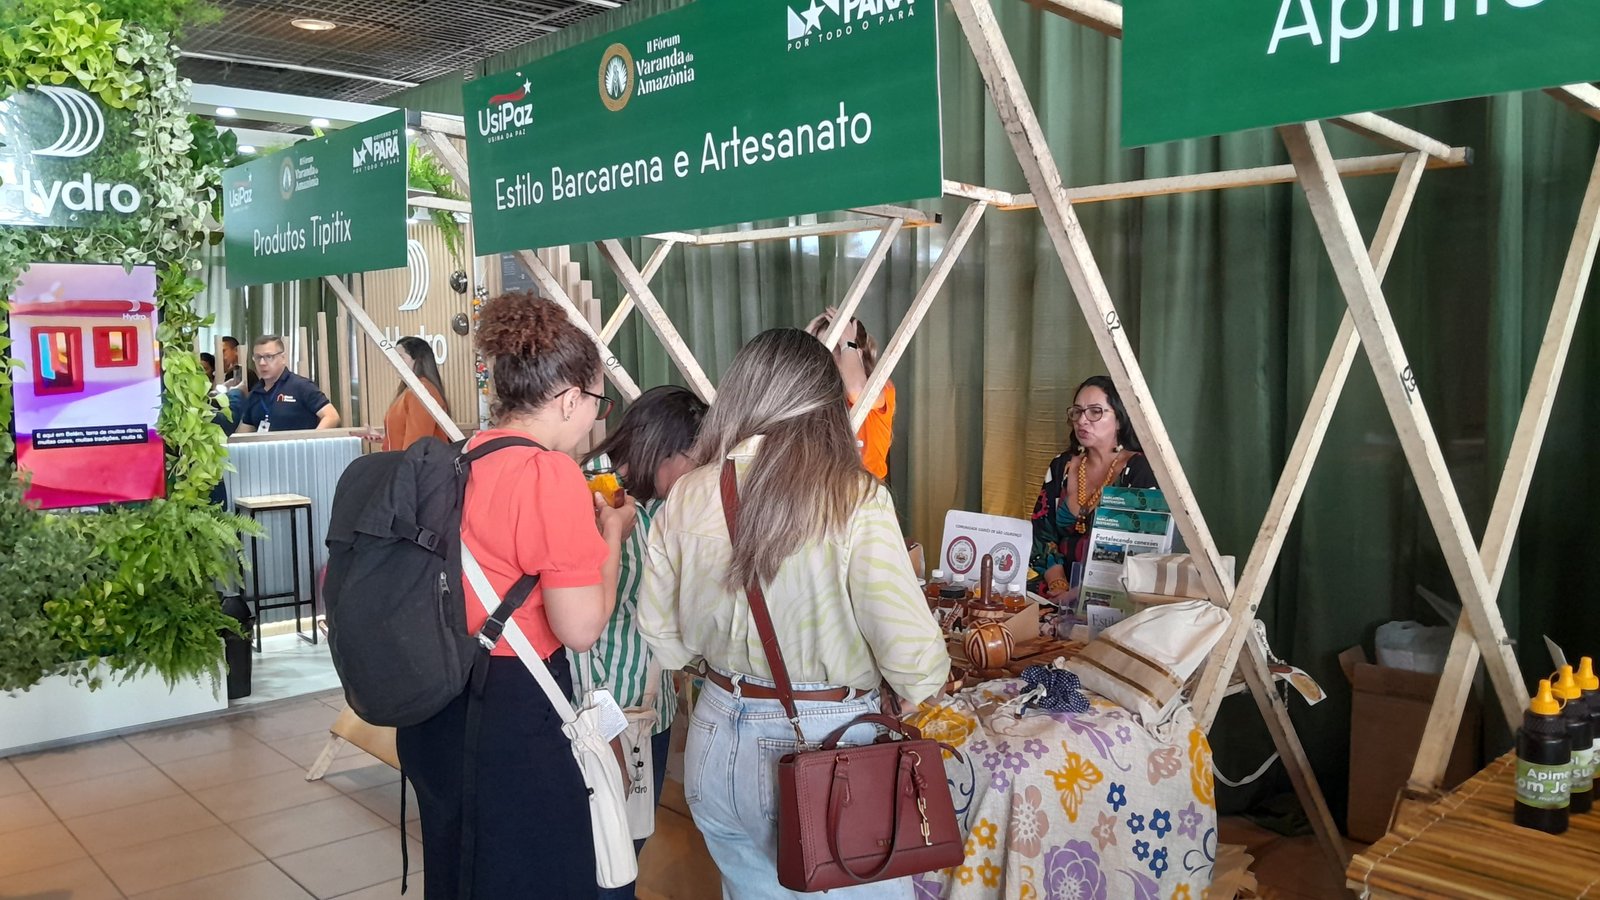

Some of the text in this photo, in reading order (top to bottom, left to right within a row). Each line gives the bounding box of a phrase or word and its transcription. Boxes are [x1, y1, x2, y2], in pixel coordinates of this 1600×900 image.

[653, 34, 681, 51] Fórum
[788, 38, 810, 51] POR
[818, 26, 853, 42] TODO
[862, 20, 869, 30] O
[636, 48, 694, 76] Varanda da
[637, 65, 695, 96] Amazônia
[478, 102, 534, 136] UsiPaz
[515, 128, 526, 136] PAZ
[496, 101, 872, 211] Estilo Barcarena e Artesanato
[0, 169, 141, 218] Hydro
[229, 186, 253, 208] UsiPaz
[253, 210, 352, 257] Produtos Tipitix
[1095, 533, 1134, 544] Fortalecendo
